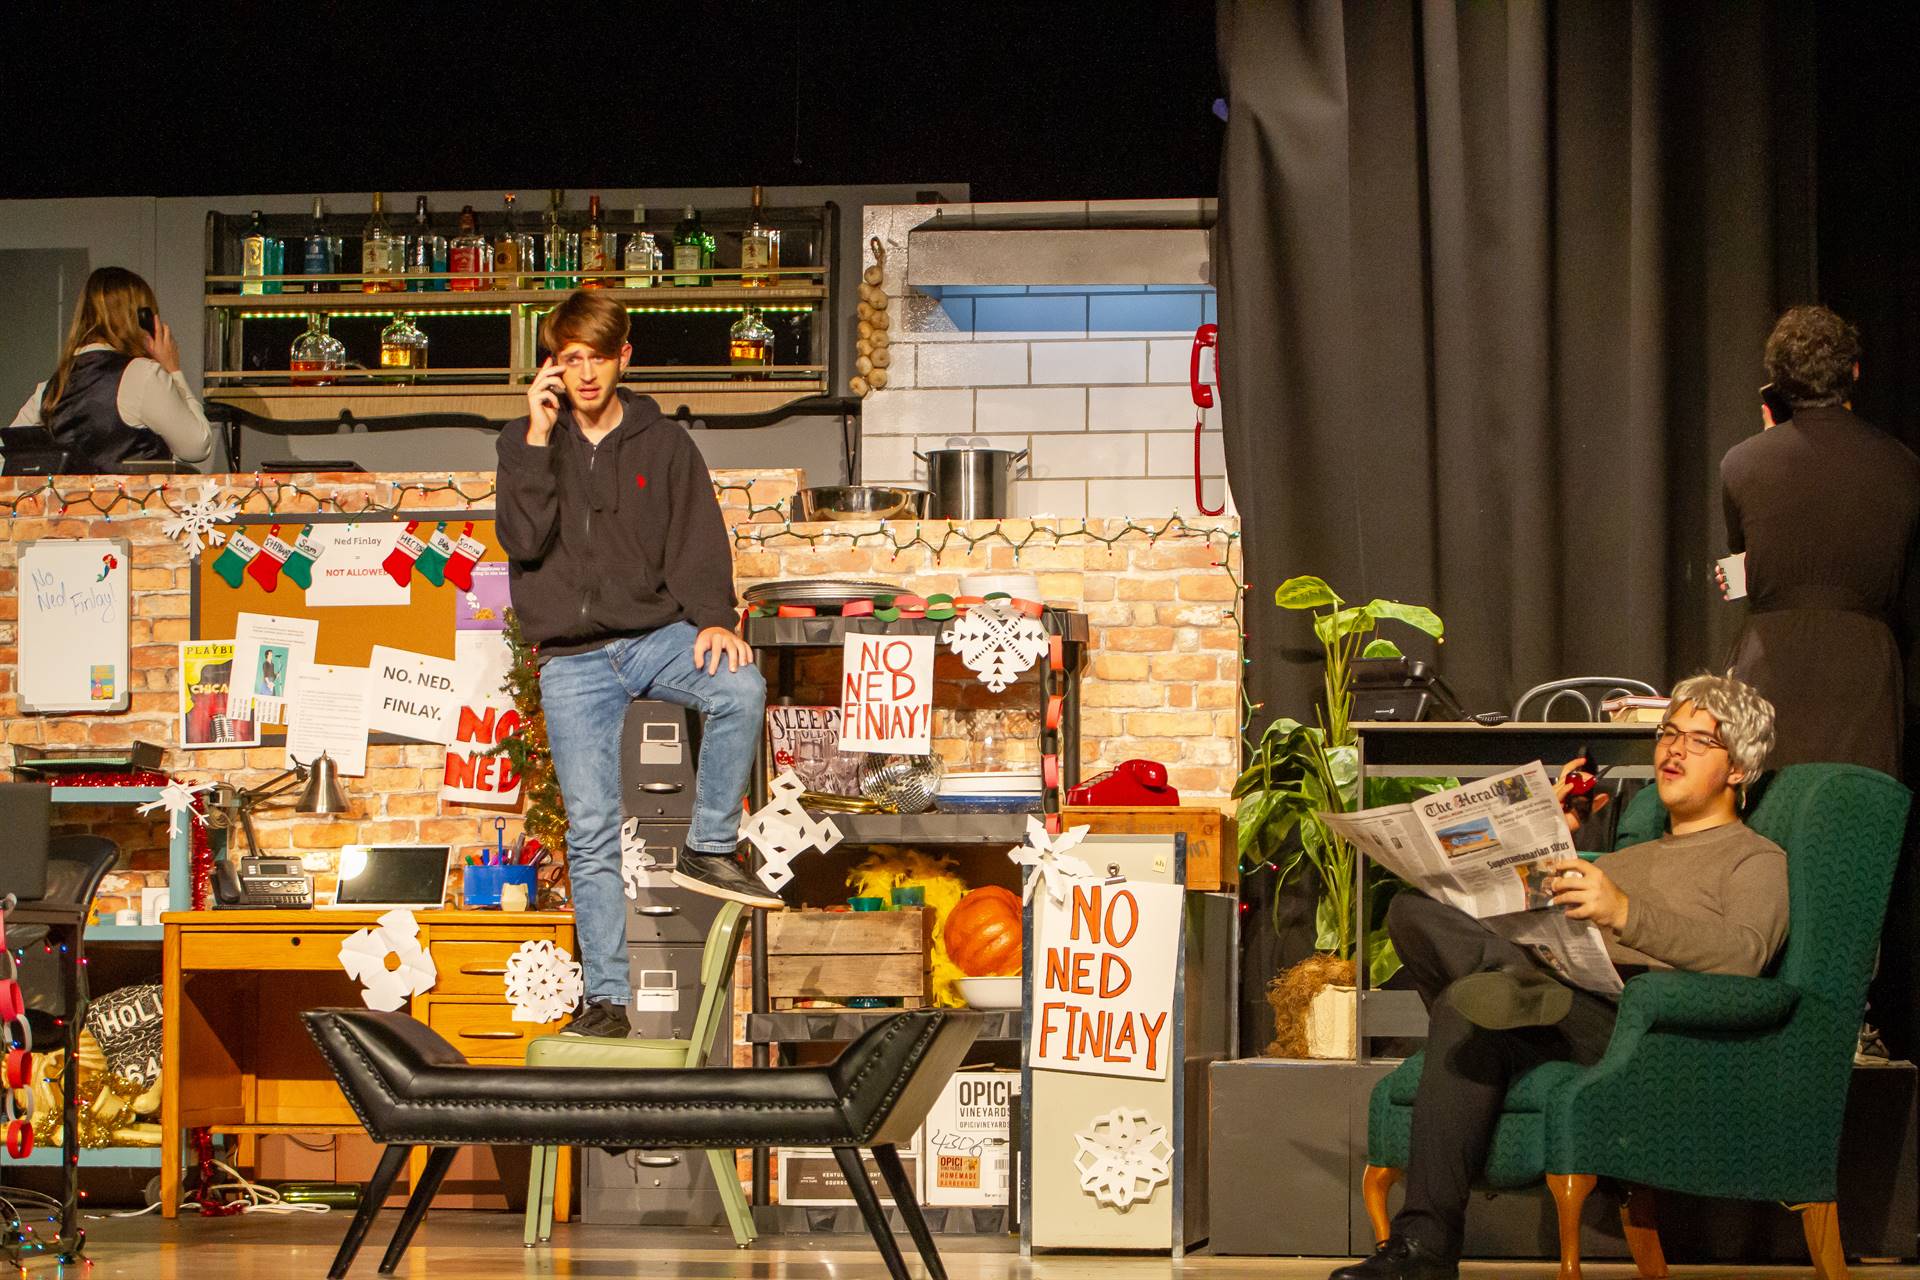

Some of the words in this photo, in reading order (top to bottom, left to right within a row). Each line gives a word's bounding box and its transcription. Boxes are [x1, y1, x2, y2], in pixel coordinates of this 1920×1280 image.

[298, 538, 317, 554] Sam
[334, 537, 352, 545] Ned
[353, 537, 382, 546] Finlay
[31, 568, 54, 592] No
[37, 580, 65, 612] Ned
[860, 640, 913, 673] NO
[383, 665, 412, 684] NO.
[417, 672, 455, 693] NED.
[845, 670, 916, 703] NED
[383, 696, 441, 721] FINLAY.
[443, 751, 522, 793] NED
[1424, 803, 1453, 818] The
[1453, 781, 1507, 808] Herald
[1070, 885, 1139, 949] NO
[1045, 946, 1132, 998] NED
[1039, 1001, 1168, 1071] FINLAY
[959, 1081, 1012, 1106] OPICI
[940, 1156, 963, 1167] OPICI
